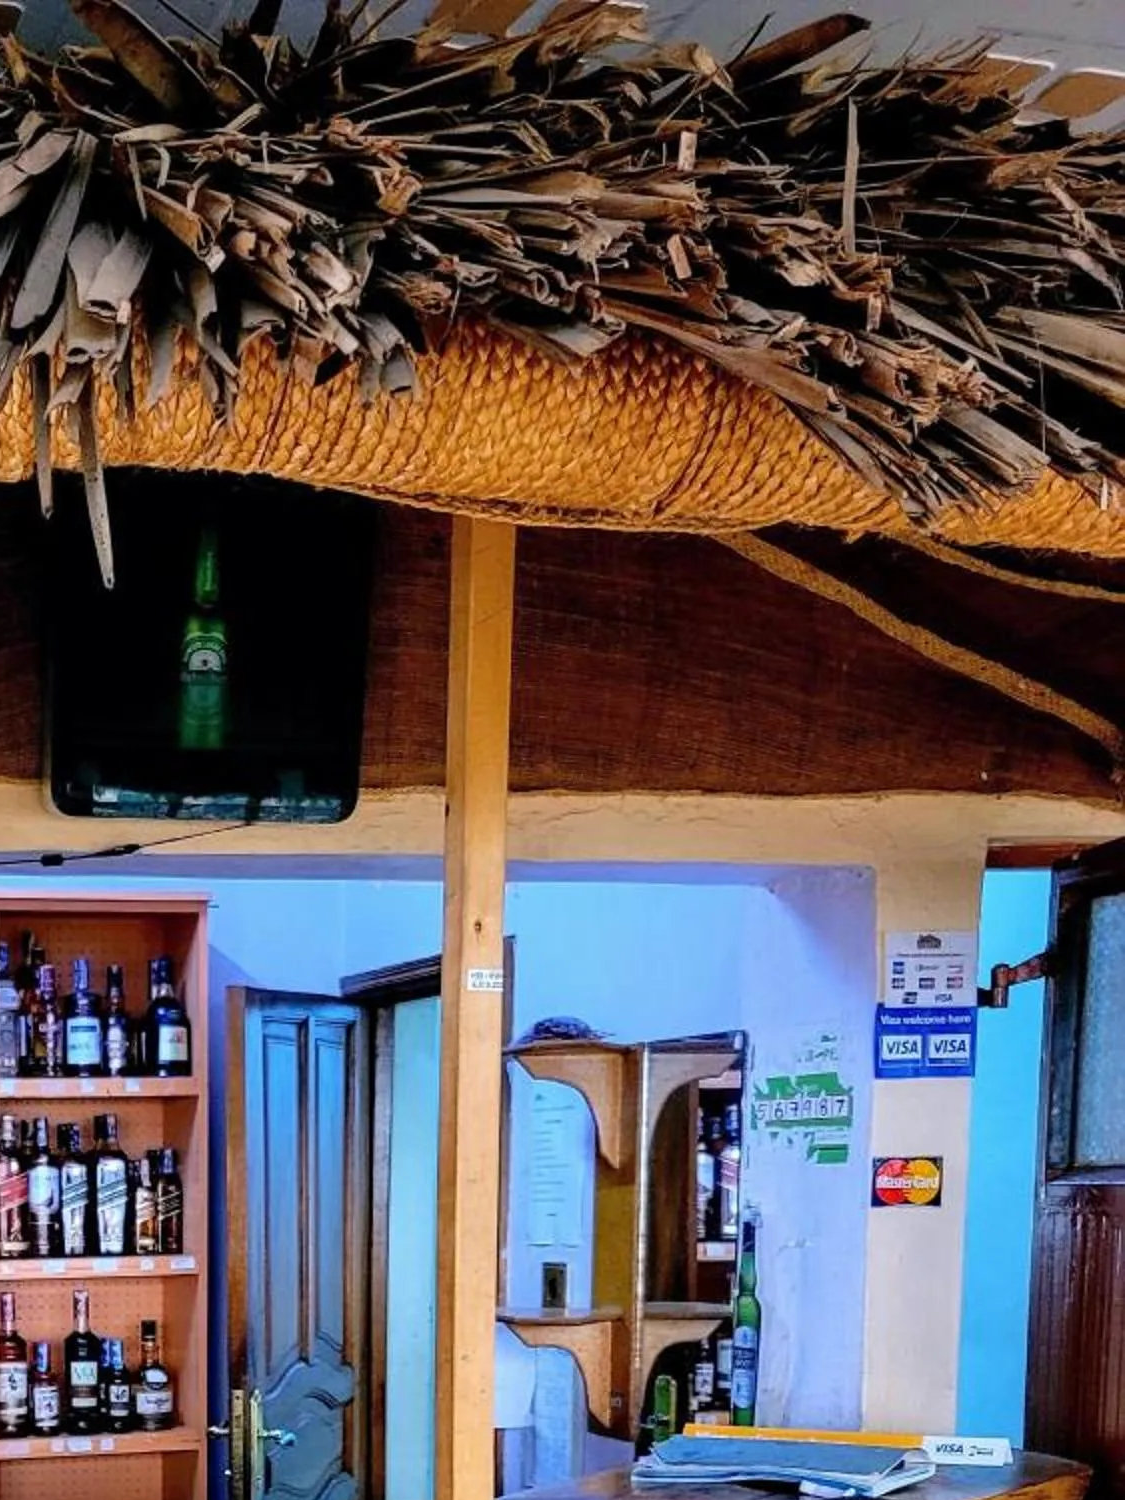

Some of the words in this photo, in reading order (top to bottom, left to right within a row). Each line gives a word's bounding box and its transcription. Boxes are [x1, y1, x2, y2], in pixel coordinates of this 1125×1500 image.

[880, 1014, 901, 1024] Visa
[903, 1013, 945, 1024] welcome
[886, 1040, 919, 1055] VISA
[934, 1039, 967, 1053] VISA
